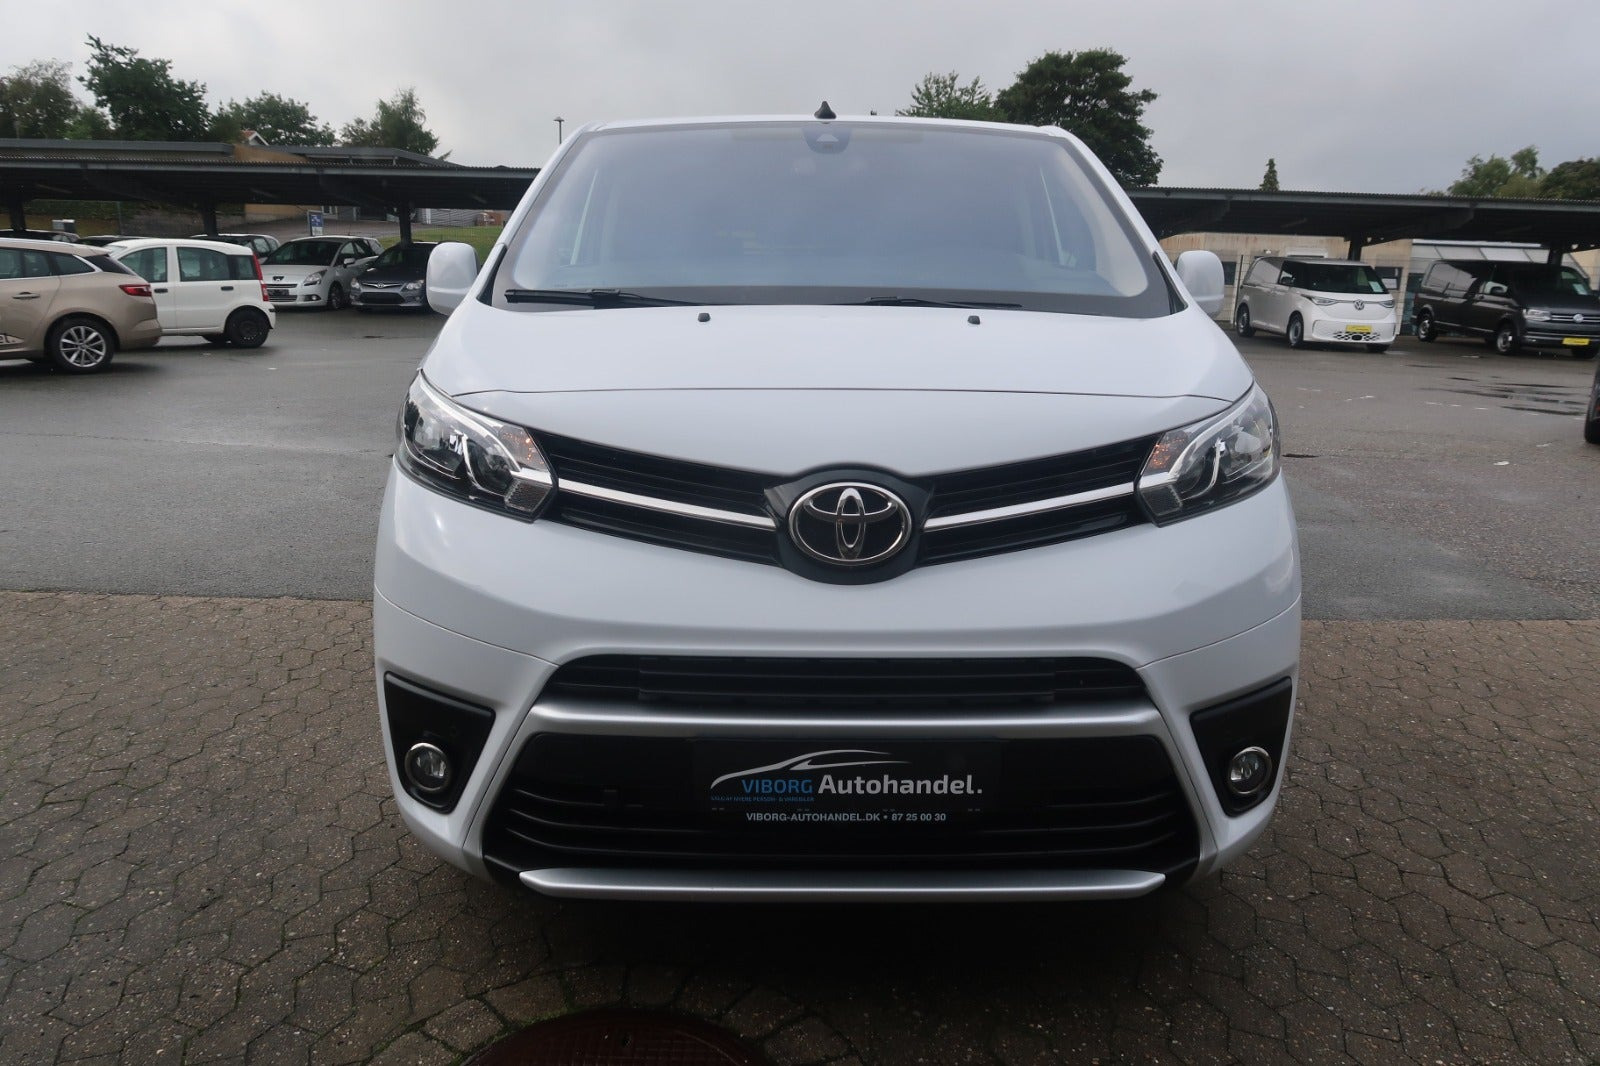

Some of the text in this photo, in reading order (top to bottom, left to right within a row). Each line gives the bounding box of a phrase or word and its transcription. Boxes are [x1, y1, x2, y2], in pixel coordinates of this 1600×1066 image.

[741, 774, 983, 794] VIBORG Autohandel.
[746, 812, 946, 821] VIBORG-AUTOHANDEL.DK 87 25 00 30
